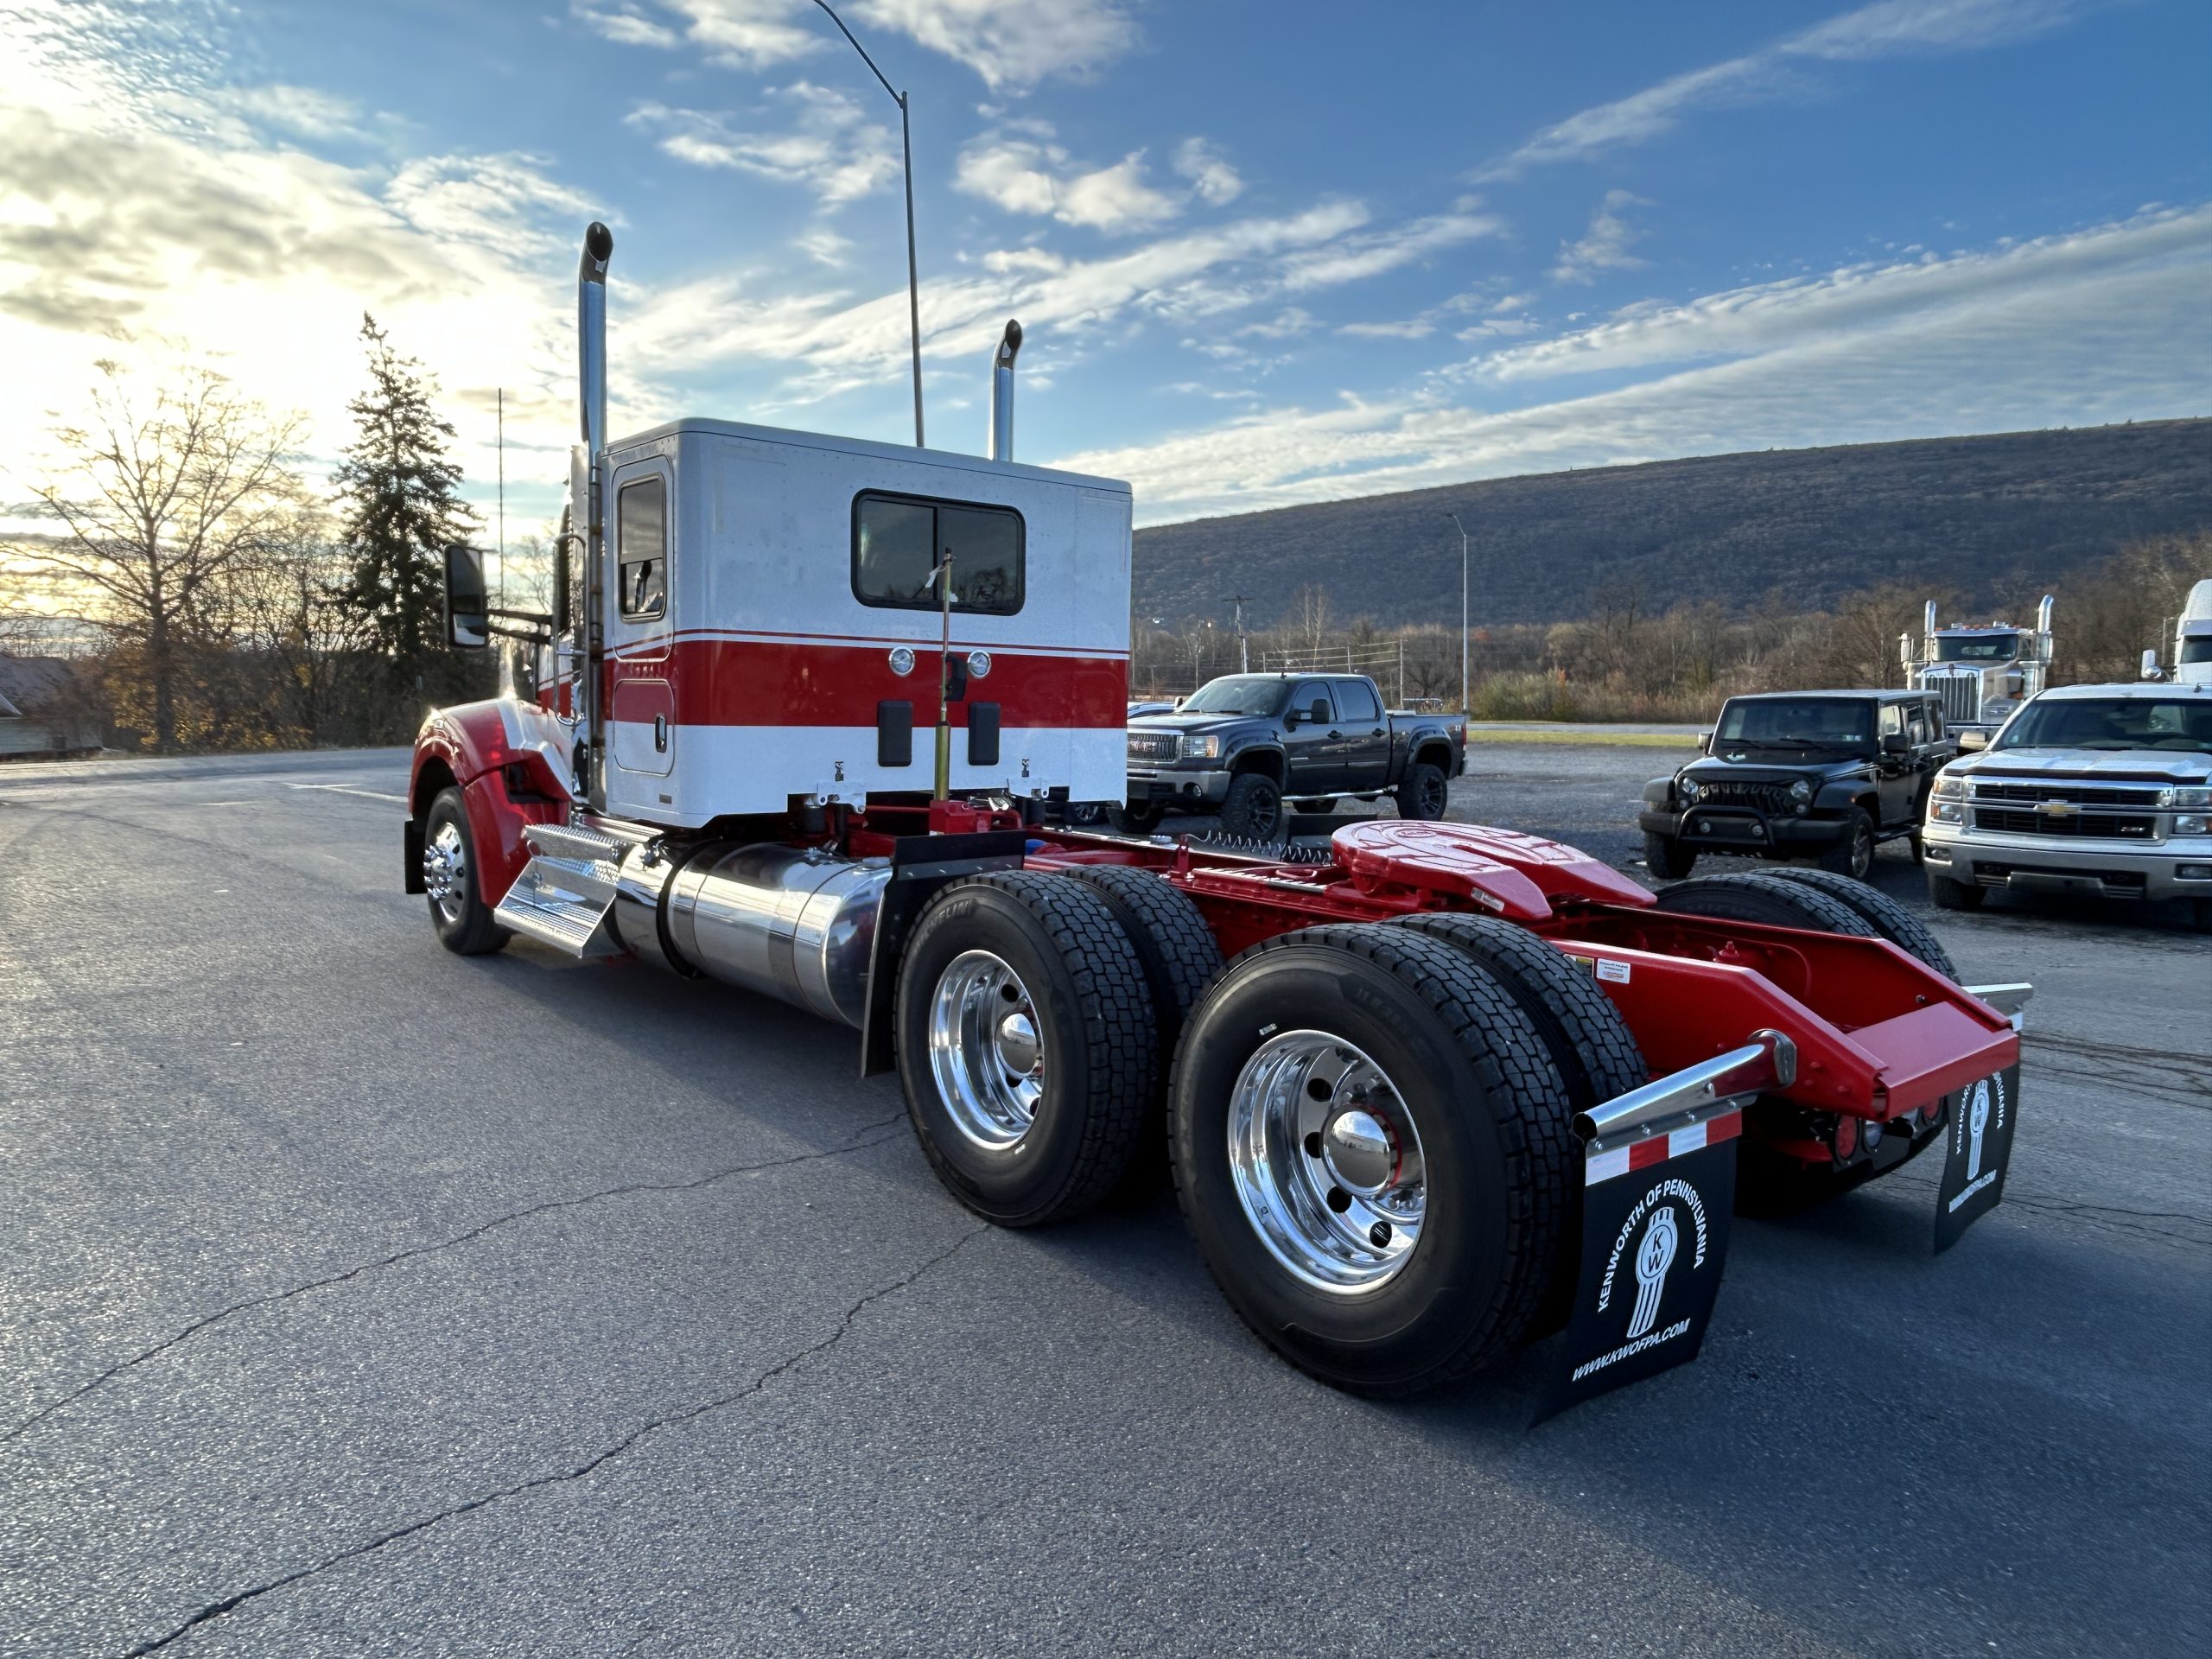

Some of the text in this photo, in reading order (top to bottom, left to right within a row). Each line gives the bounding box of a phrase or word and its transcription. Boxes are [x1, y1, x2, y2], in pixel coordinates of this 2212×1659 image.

[1598, 1179, 1707, 1313] KENWORTH OF PENNSYLVANIA
[1572, 1318, 1691, 1382] WWW.KWOFPA.COM
